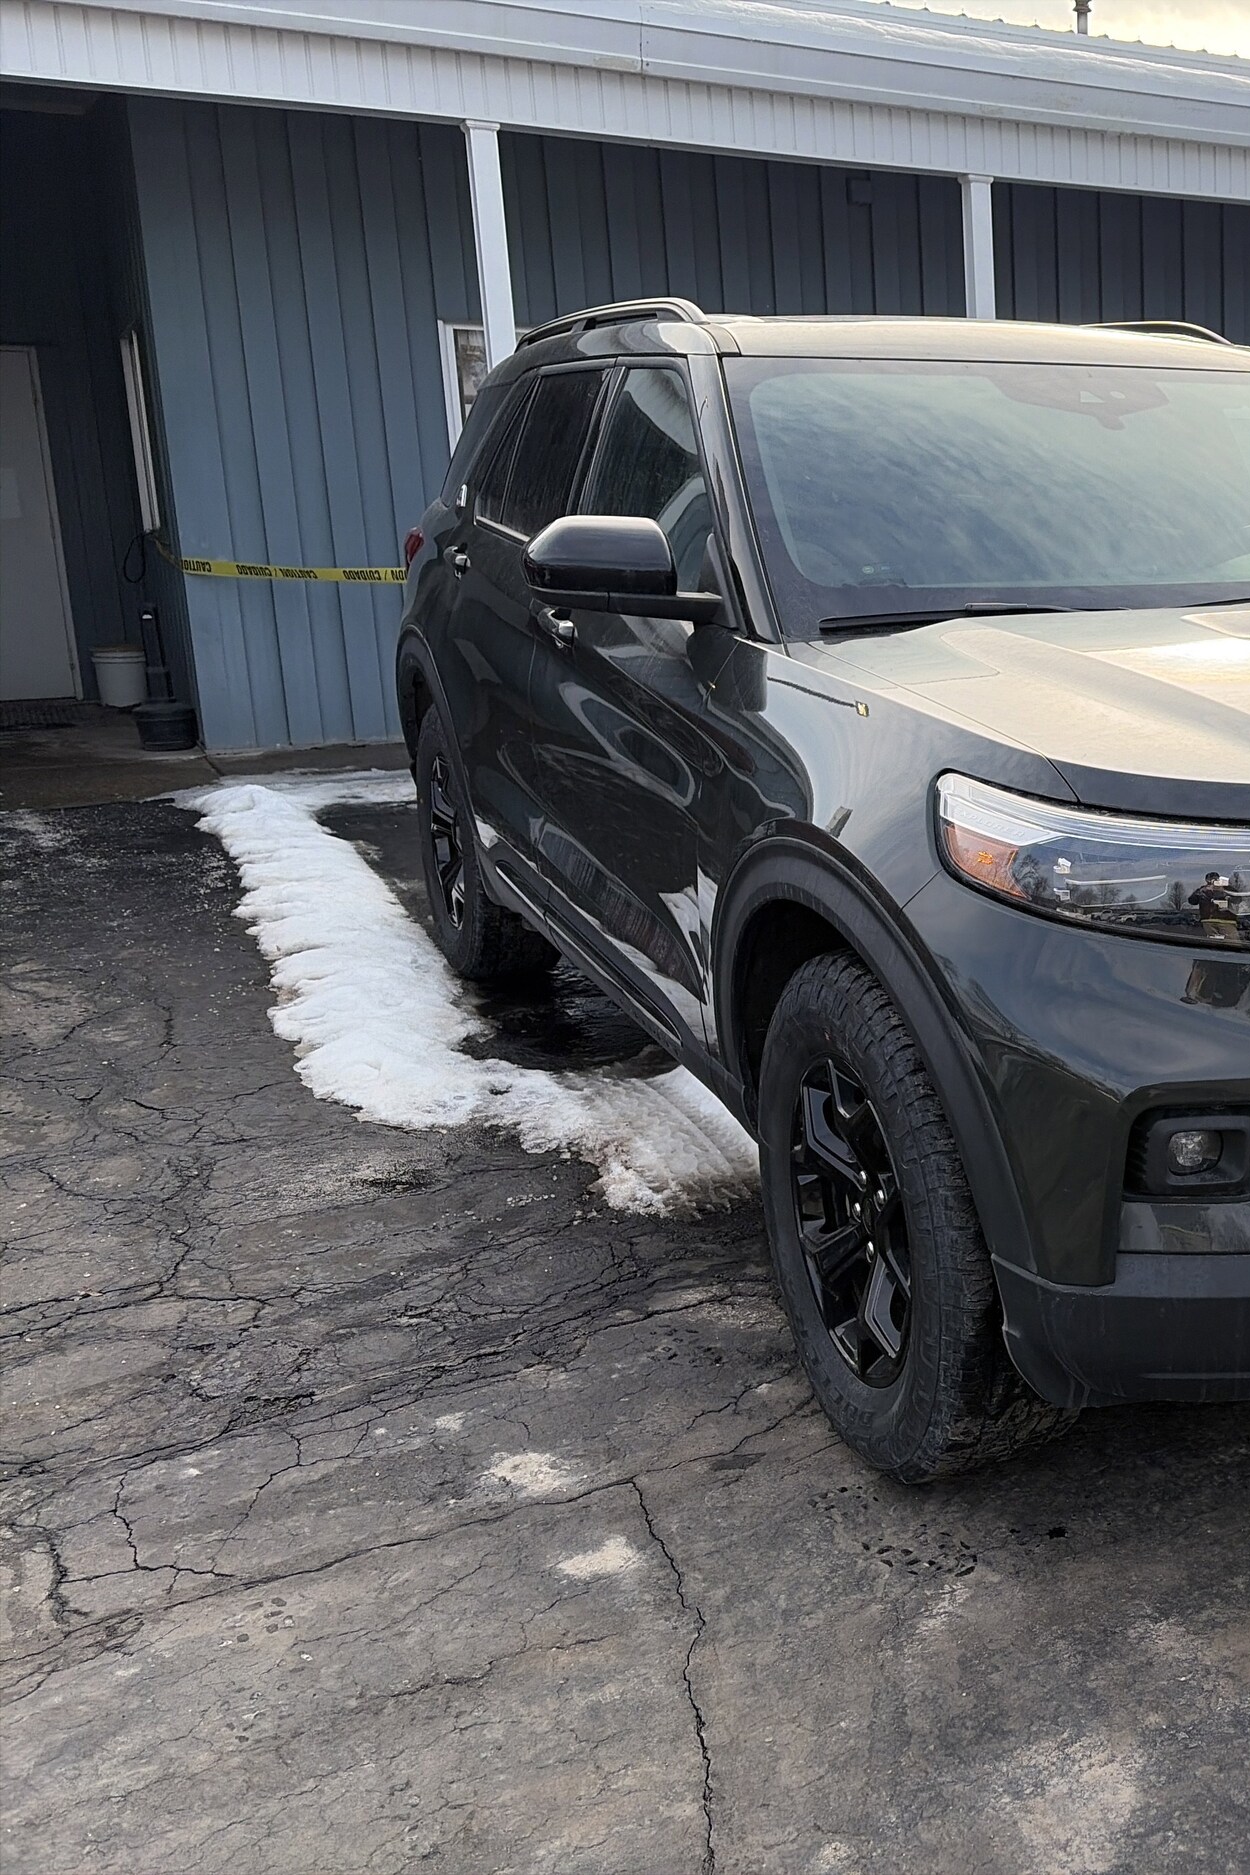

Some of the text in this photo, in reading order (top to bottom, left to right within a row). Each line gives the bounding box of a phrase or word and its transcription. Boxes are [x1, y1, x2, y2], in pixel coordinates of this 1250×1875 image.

[236, 564, 273, 577] CUIDADO
[279, 567, 318, 579] CAUTION
[342, 569, 382, 581] CUIDADO
